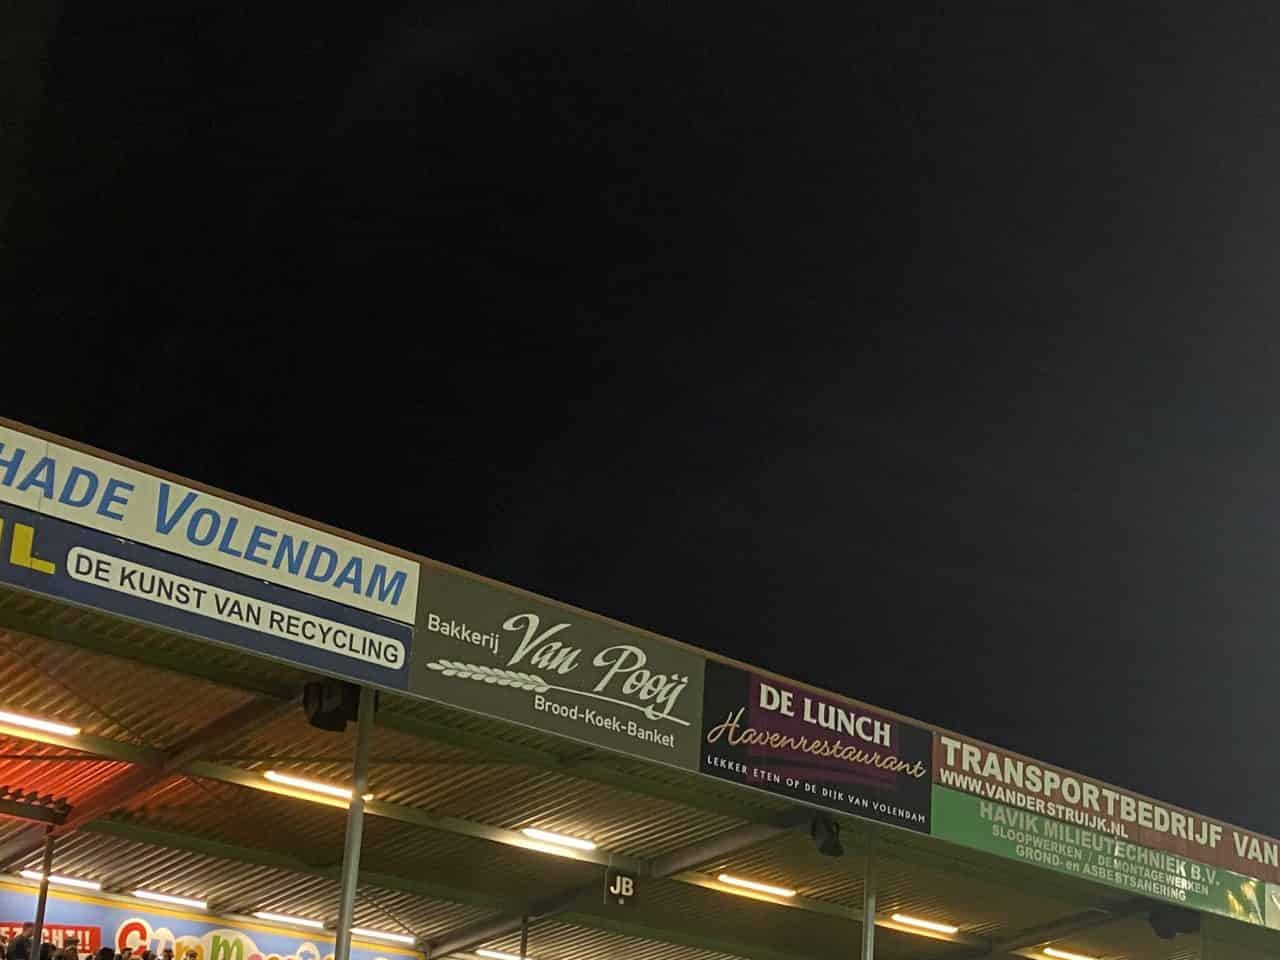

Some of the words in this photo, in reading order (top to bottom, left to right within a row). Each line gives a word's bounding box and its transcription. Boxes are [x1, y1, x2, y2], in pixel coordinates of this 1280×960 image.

[154, 483, 408, 607] VOLENDAM
[75, 553, 112, 582] DE
[120, 568, 207, 609] KUNST
[214, 594, 261, 626] VAN
[269, 611, 399, 664] RECYCLING
[427, 613, 501, 655] Bakkerij
[503, 613, 583, 675] Van
[533, 695, 676, 749] Brood-Koek-Banket
[707, 705, 927, 779] Havenrestaurant
[759, 682, 795, 717] DE
[802, 697, 892, 747] LUNCH
[706, 754, 749, 776] LEKKER
[752, 766, 781, 785] ETEN
[785, 775, 801, 789] OP
[804, 781, 818, 794] DE
[822, 786, 844, 802] DIJK
[848, 792, 869, 808] VAN
[872, 799, 926, 824] VOLENDAM
[940, 768, 1129, 839] WWW.VANDERSTRUIJK.NL
[941, 736, 1223, 848] TRANSPORTBEDRIJF
[1233, 832, 1279, 868] VAN
[980, 800, 1039, 833] HAVIK
[1043, 820, 1187, 877] MILIEUTECHNIEK
[1190, 864, 1220, 886] B.V.
[991, 824, 1083, 861] SLOOPWERKEN
[1098, 851, 1209, 896] DEMONTAGEWERKEN
[610, 875, 634, 897] JB
[1082, 861, 1187, 901] ASBESTSANERING
